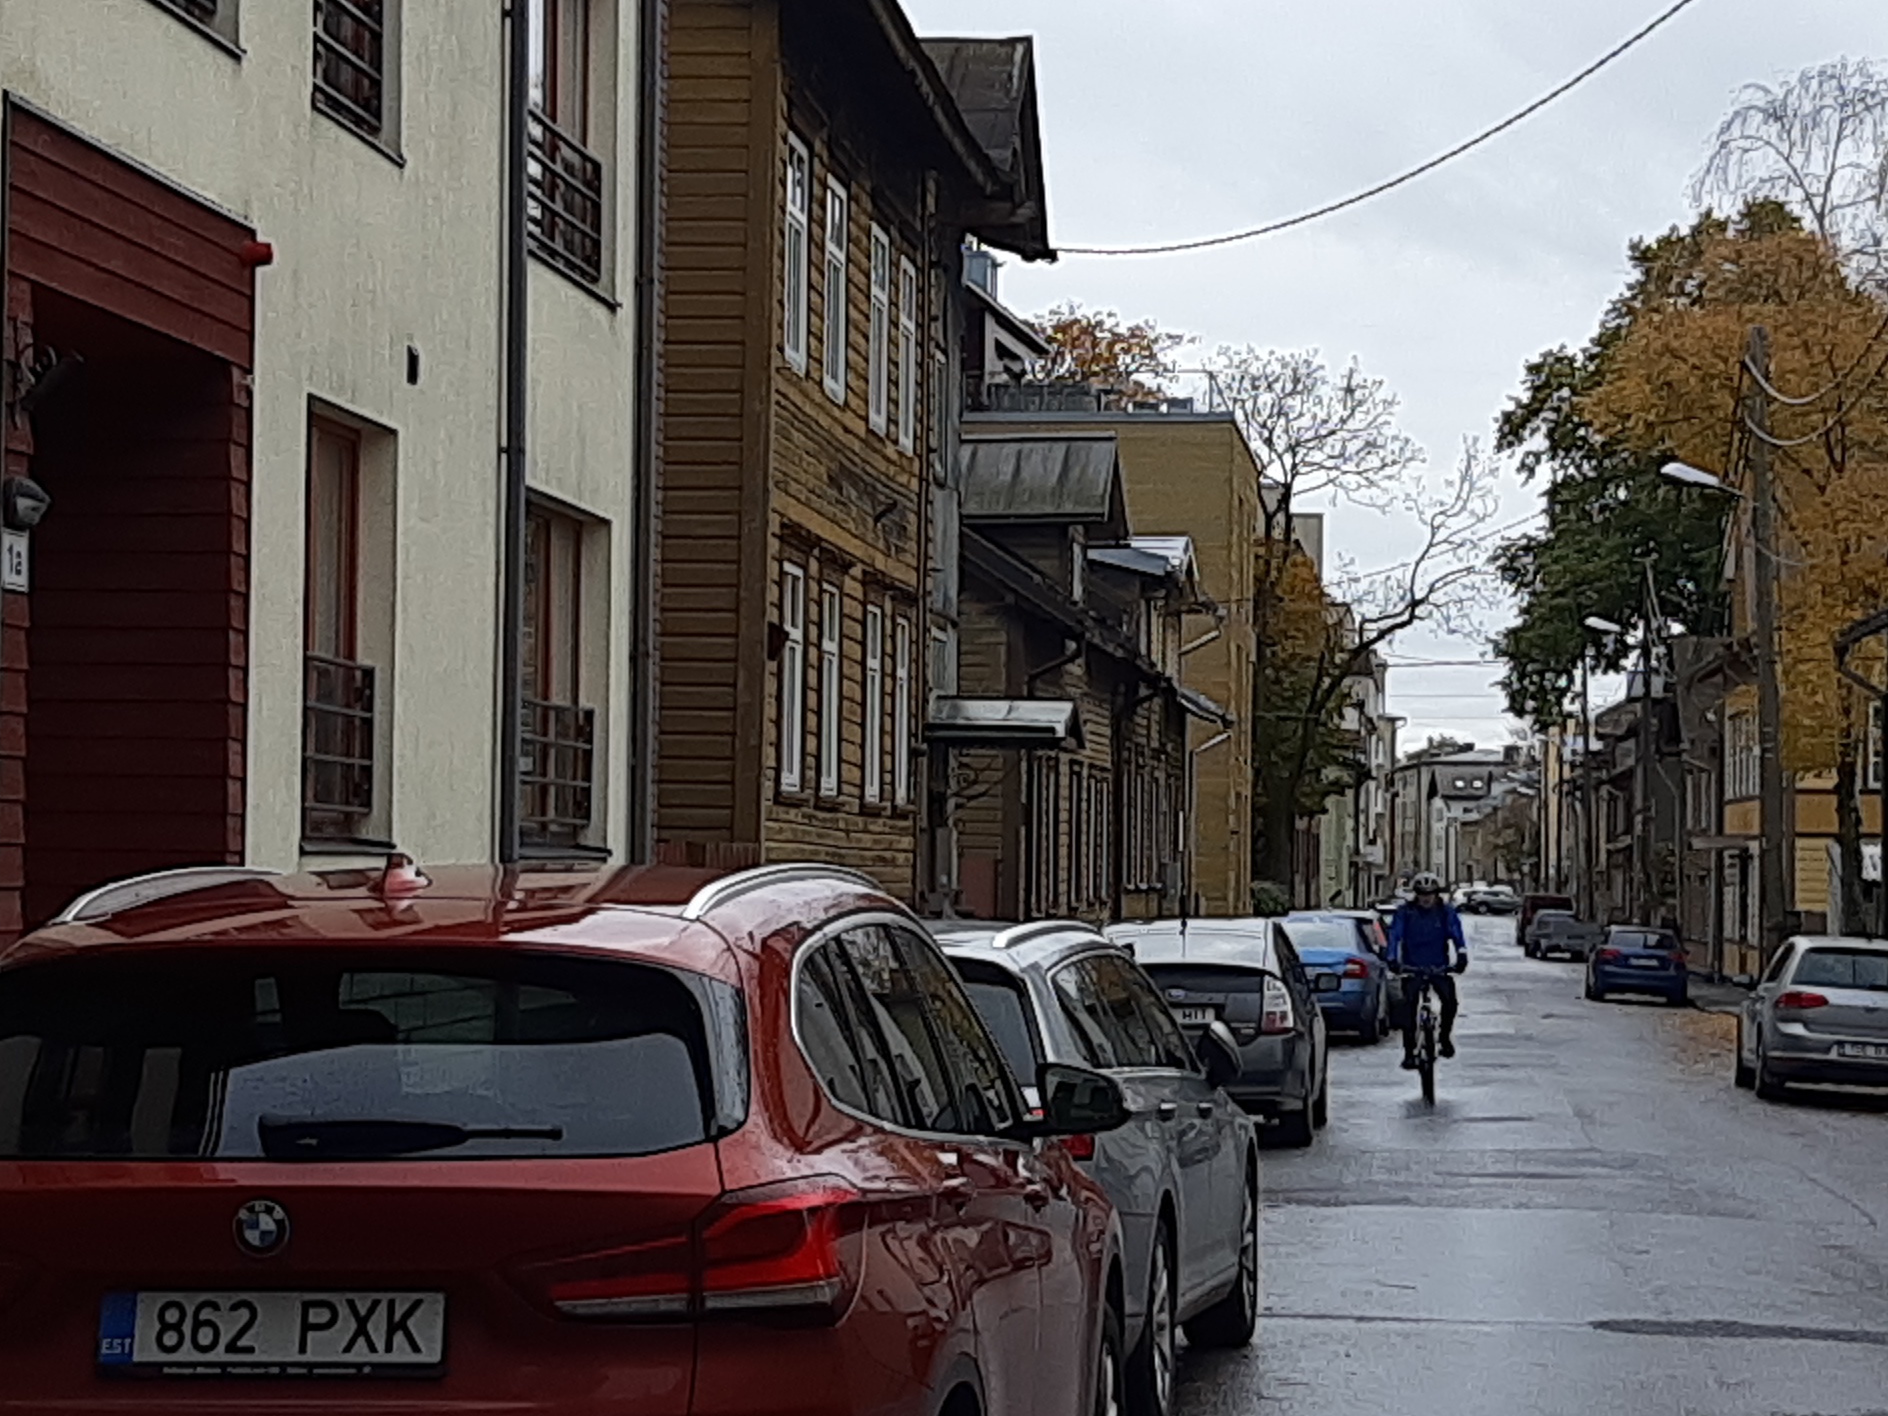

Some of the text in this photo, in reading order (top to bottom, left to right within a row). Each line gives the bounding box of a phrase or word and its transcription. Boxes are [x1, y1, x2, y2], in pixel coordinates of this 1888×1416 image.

[6, 541, 23, 577] 1a
[154, 1297, 426, 1355] 862 PXK
[101, 1337, 132, 1355] EST
